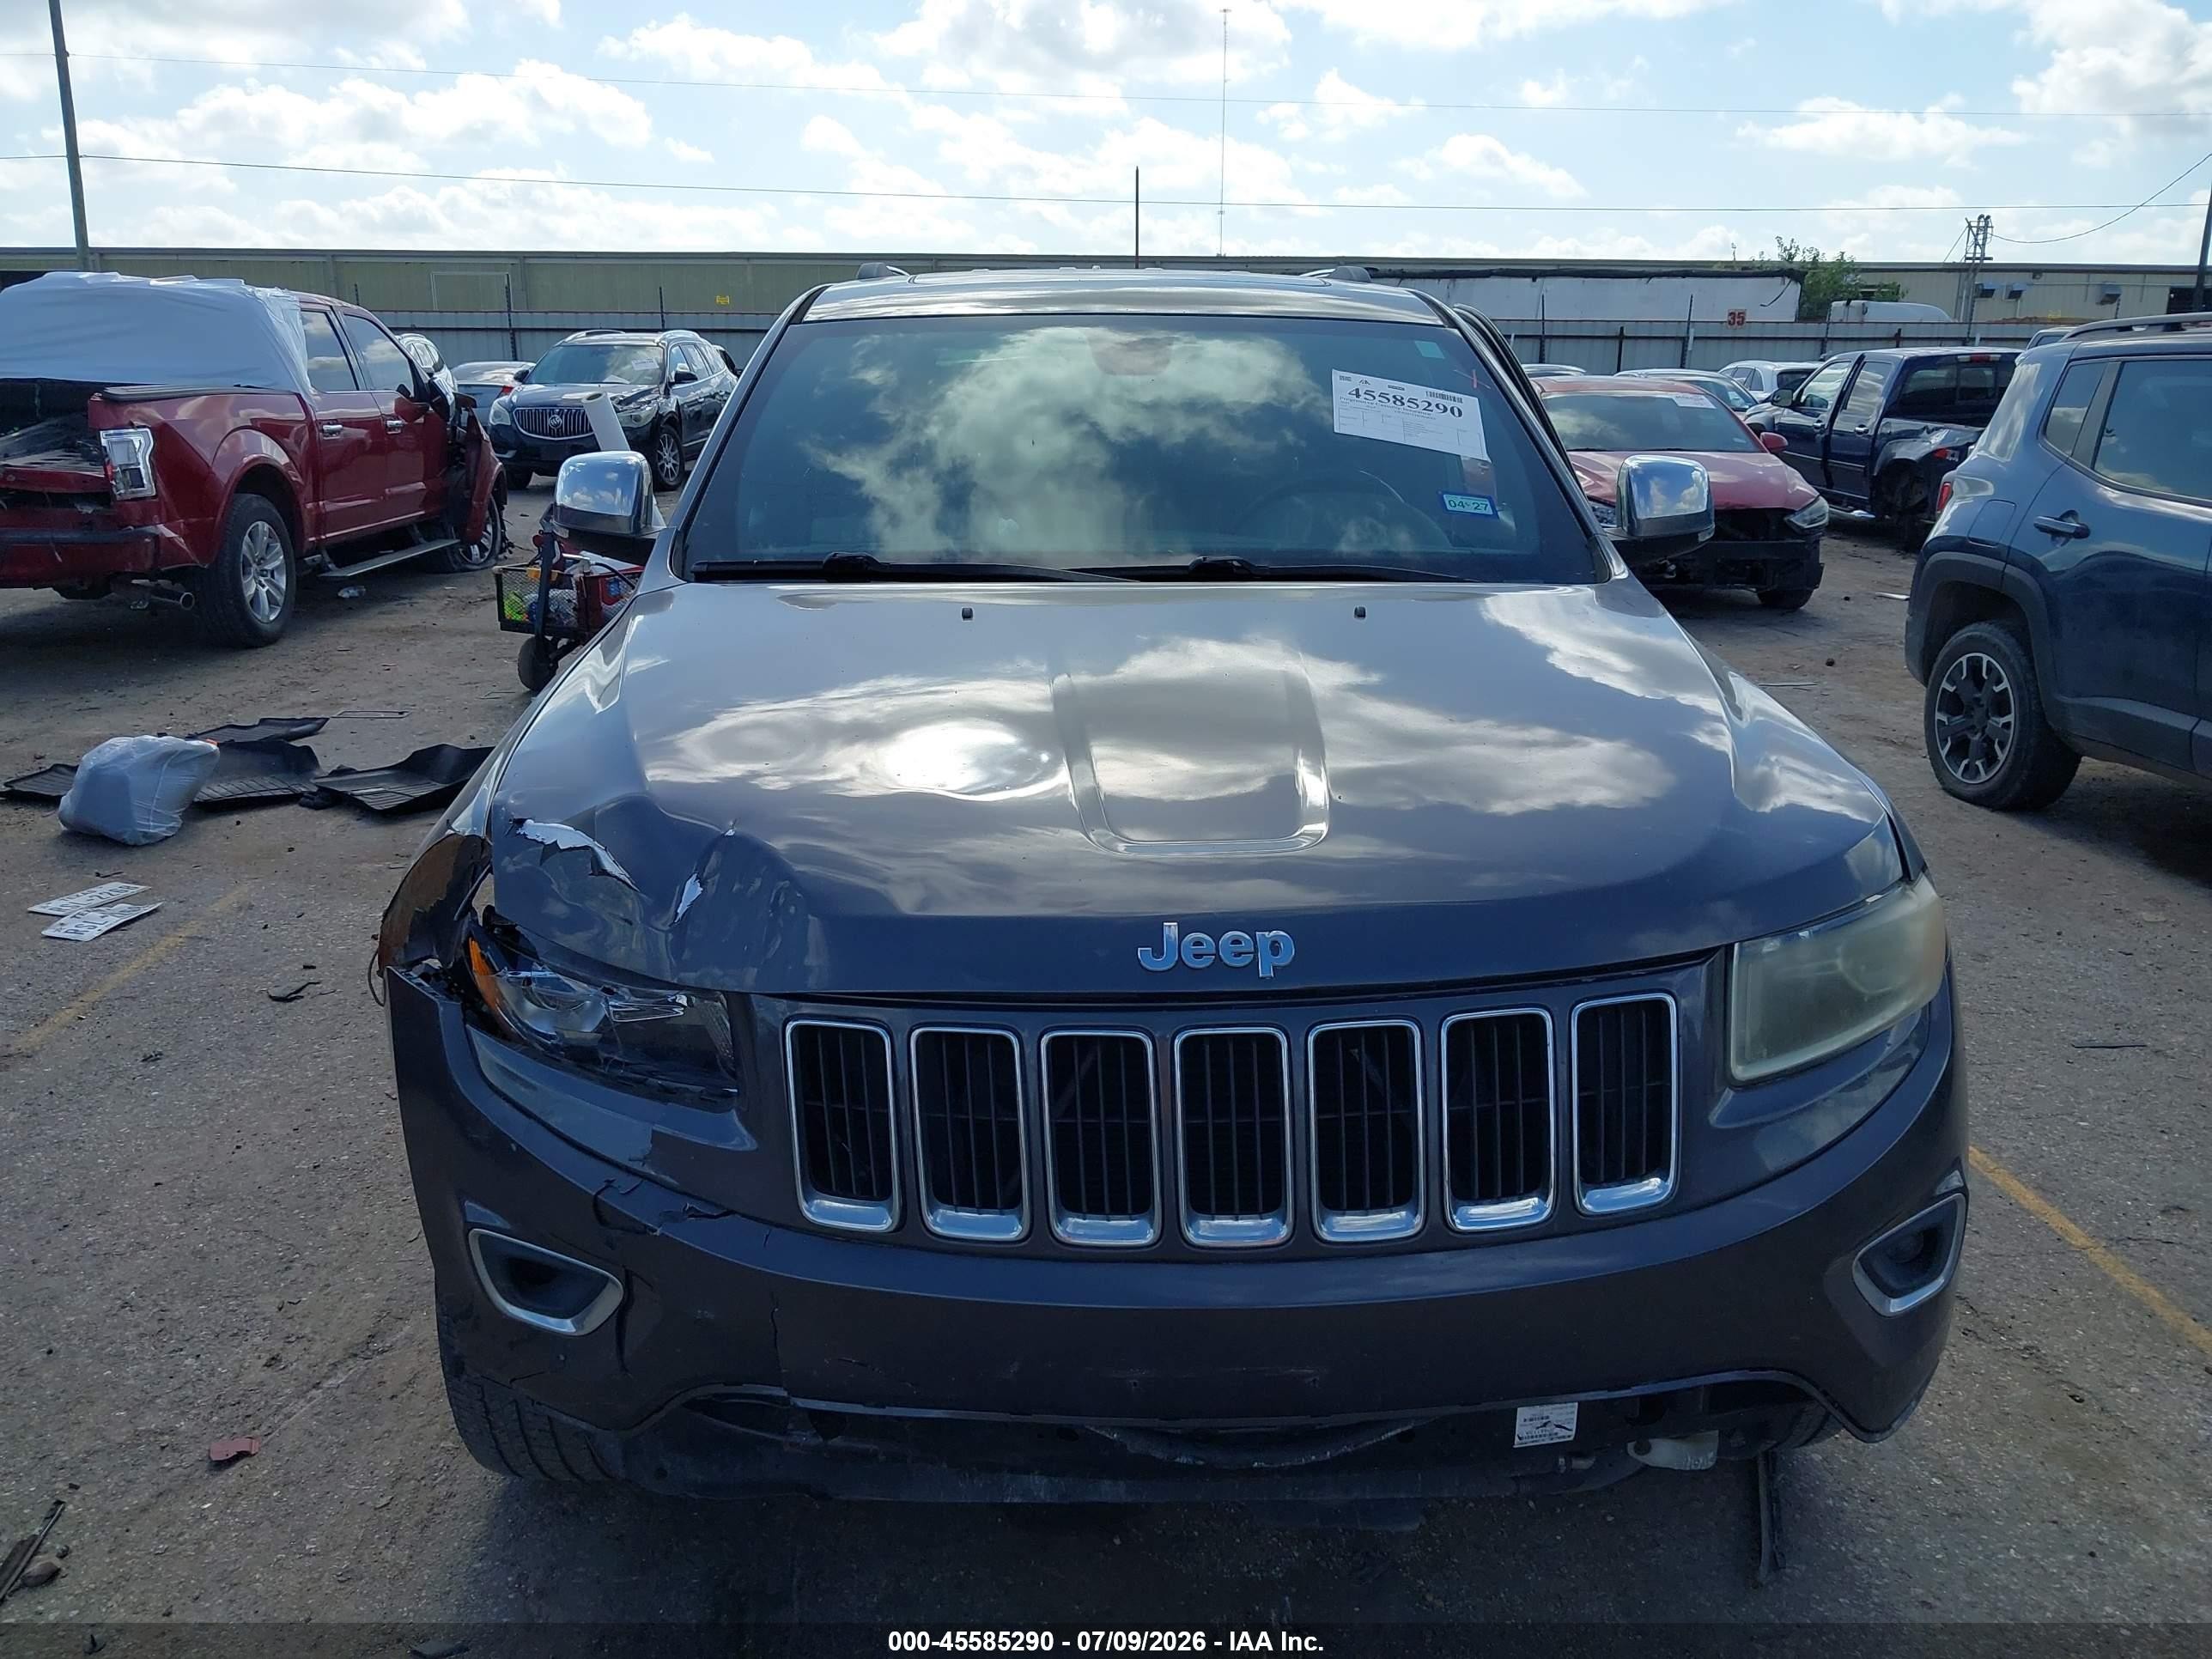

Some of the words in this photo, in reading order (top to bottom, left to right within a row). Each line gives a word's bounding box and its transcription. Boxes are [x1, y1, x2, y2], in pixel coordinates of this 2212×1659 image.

[1728, 311, 1746, 326] 35
[1347, 387, 1463, 418] 45585290
[1137, 921, 1296, 979] Jeep
